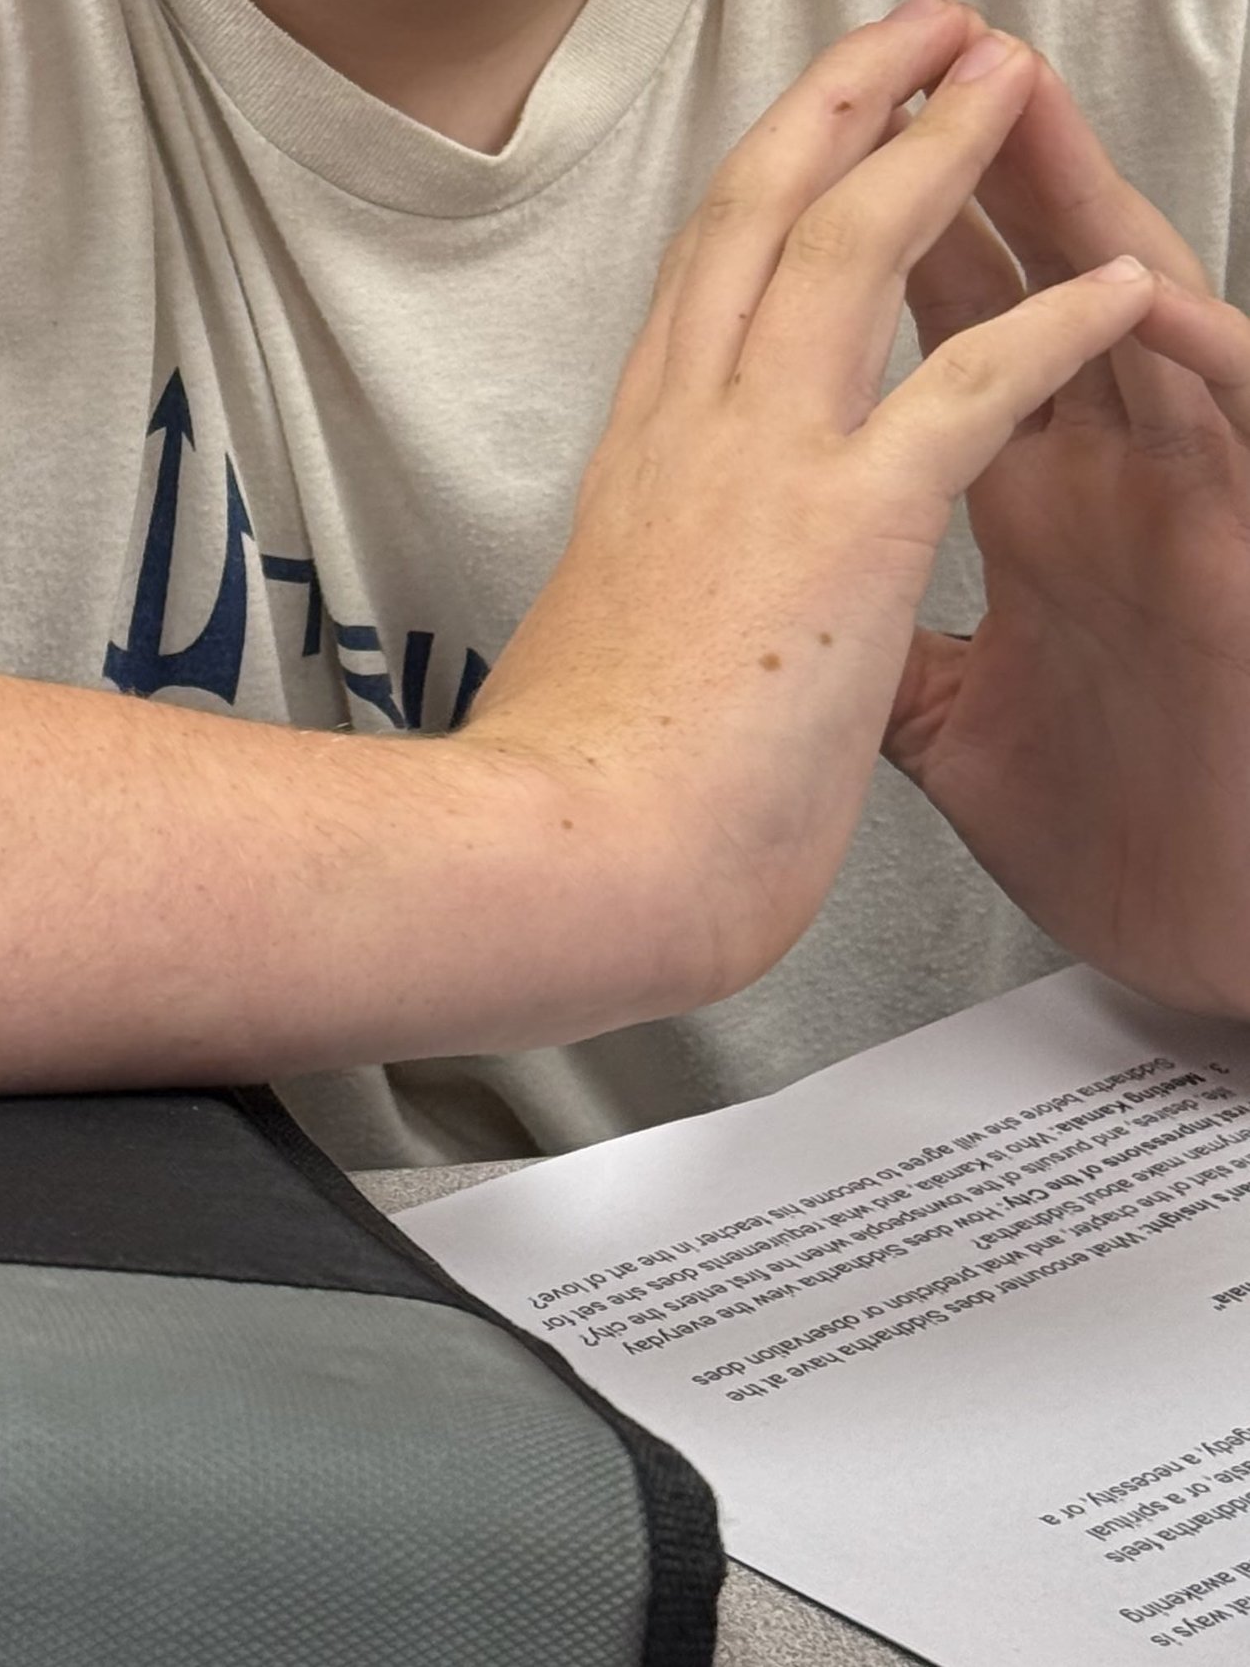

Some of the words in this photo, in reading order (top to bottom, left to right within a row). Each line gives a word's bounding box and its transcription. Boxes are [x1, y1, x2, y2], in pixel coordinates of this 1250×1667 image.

[1076, 1058, 1175, 1097] Siddhartha
[1123, 1072, 1206, 1103] Meeting
[1019, 1093, 1086, 1120] before
[1048, 1100, 1134, 1135] Kamala:
[1124, 1099, 1199, 1127] desires,
[1212, 1105, 1250, 1123] irst
[983, 1117, 1022, 1135] she
[1090, 1126, 1130, 1147] and
[951, 1132, 988, 1151] will
[1005, 1132, 1058, 1153] Who
[1101, 1118, 1222, 1167] Impressions
[898, 1145, 955, 1171] agree
[985, 1149, 1014, 1162] is
[1020, 1139, 1094, 1174] pursuits
[876, 1168, 904, 1180] to
[906, 1158, 994, 1190] Kamala,
[997, 1171, 1023, 1187] of
[1077, 1164, 1104, 1181] of
[1131, 1156, 1187, 1182] make
[1185, 1165, 1234, 1187] start
[799, 1177, 883, 1208] become
[966, 1180, 1005, 1196] the
[1044, 1174, 1085, 1191] the
[1077, 1179, 1135, 1206] about
[1167, 1181, 1192, 1197] of
[870, 1189, 912, 1210] and
[996, 1188, 1050, 1211] City:
[1136, 1190, 1176, 1207] the
[767, 1203, 807, 1219] his
[820, 1205, 876, 1228] what
[849, 1193, 973, 1241] townspeople
[952, 1207, 1005, 1229] How
[1059, 1205, 1139, 1237] chapter,
[1137, 1199, 1220, 1234] Insight:
[695, 1215, 773, 1246] teacher
[902, 1224, 954, 1247] does
[971, 1201, 1085, 1250] Siddhartha?
[670, 1241, 701, 1254] in
[698, 1222, 826, 1271] requirements
[794, 1238, 854, 1262] when
[1024, 1235, 1066, 1257] and
[1084, 1232, 1147, 1257] What
[637, 1250, 678, 1266] the
[766, 1258, 803, 1272] he
[797, 1244, 908, 1287] Siddhartha
[975, 1250, 1030, 1274] what
[582, 1273, 608, 1290] of
[604, 1262, 639, 1280] art
[645, 1268, 699, 1290] does
[724, 1269, 772, 1290] first
[994, 1252, 1090, 1294] encounter
[528, 1282, 590, 1310] love?
[606, 1286, 648, 1305] she
[663, 1284, 728, 1312] enters
[751, 1284, 802, 1306] view
[882, 1266, 980, 1309] prediction
[569, 1301, 608, 1321] set
[715, 1302, 757, 1319] the
[860, 1305, 886, 1319] or
[943, 1290, 996, 1313] does
[542, 1314, 577, 1331] for
[627, 1308, 668, 1325] the
[579, 1321, 628, 1347] city?
[622, 1315, 717, 1355] everyday
[744, 1315, 860, 1364] observation
[837, 1310, 949, 1356] Siddhartha
[692, 1361, 746, 1385] does
[786, 1352, 846, 1377] have
[725, 1383, 769, 1401] the
[759, 1373, 788, 1389] at
[1179, 1454, 1202, 1465] a
[1079, 1461, 1185, 1507] necessity,
[1183, 1483, 1211, 1498] or
[1163, 1493, 1187, 1505] a
[1038, 1514, 1061, 1526] a
[1059, 1504, 1087, 1519] or
[1085, 1501, 1169, 1541] spiritual
[1104, 1537, 1165, 1563] feels
[1119, 1572, 1236, 1623] awakening
[1172, 1609, 1234, 1637] ways
[1150, 1632, 1182, 1647] is
